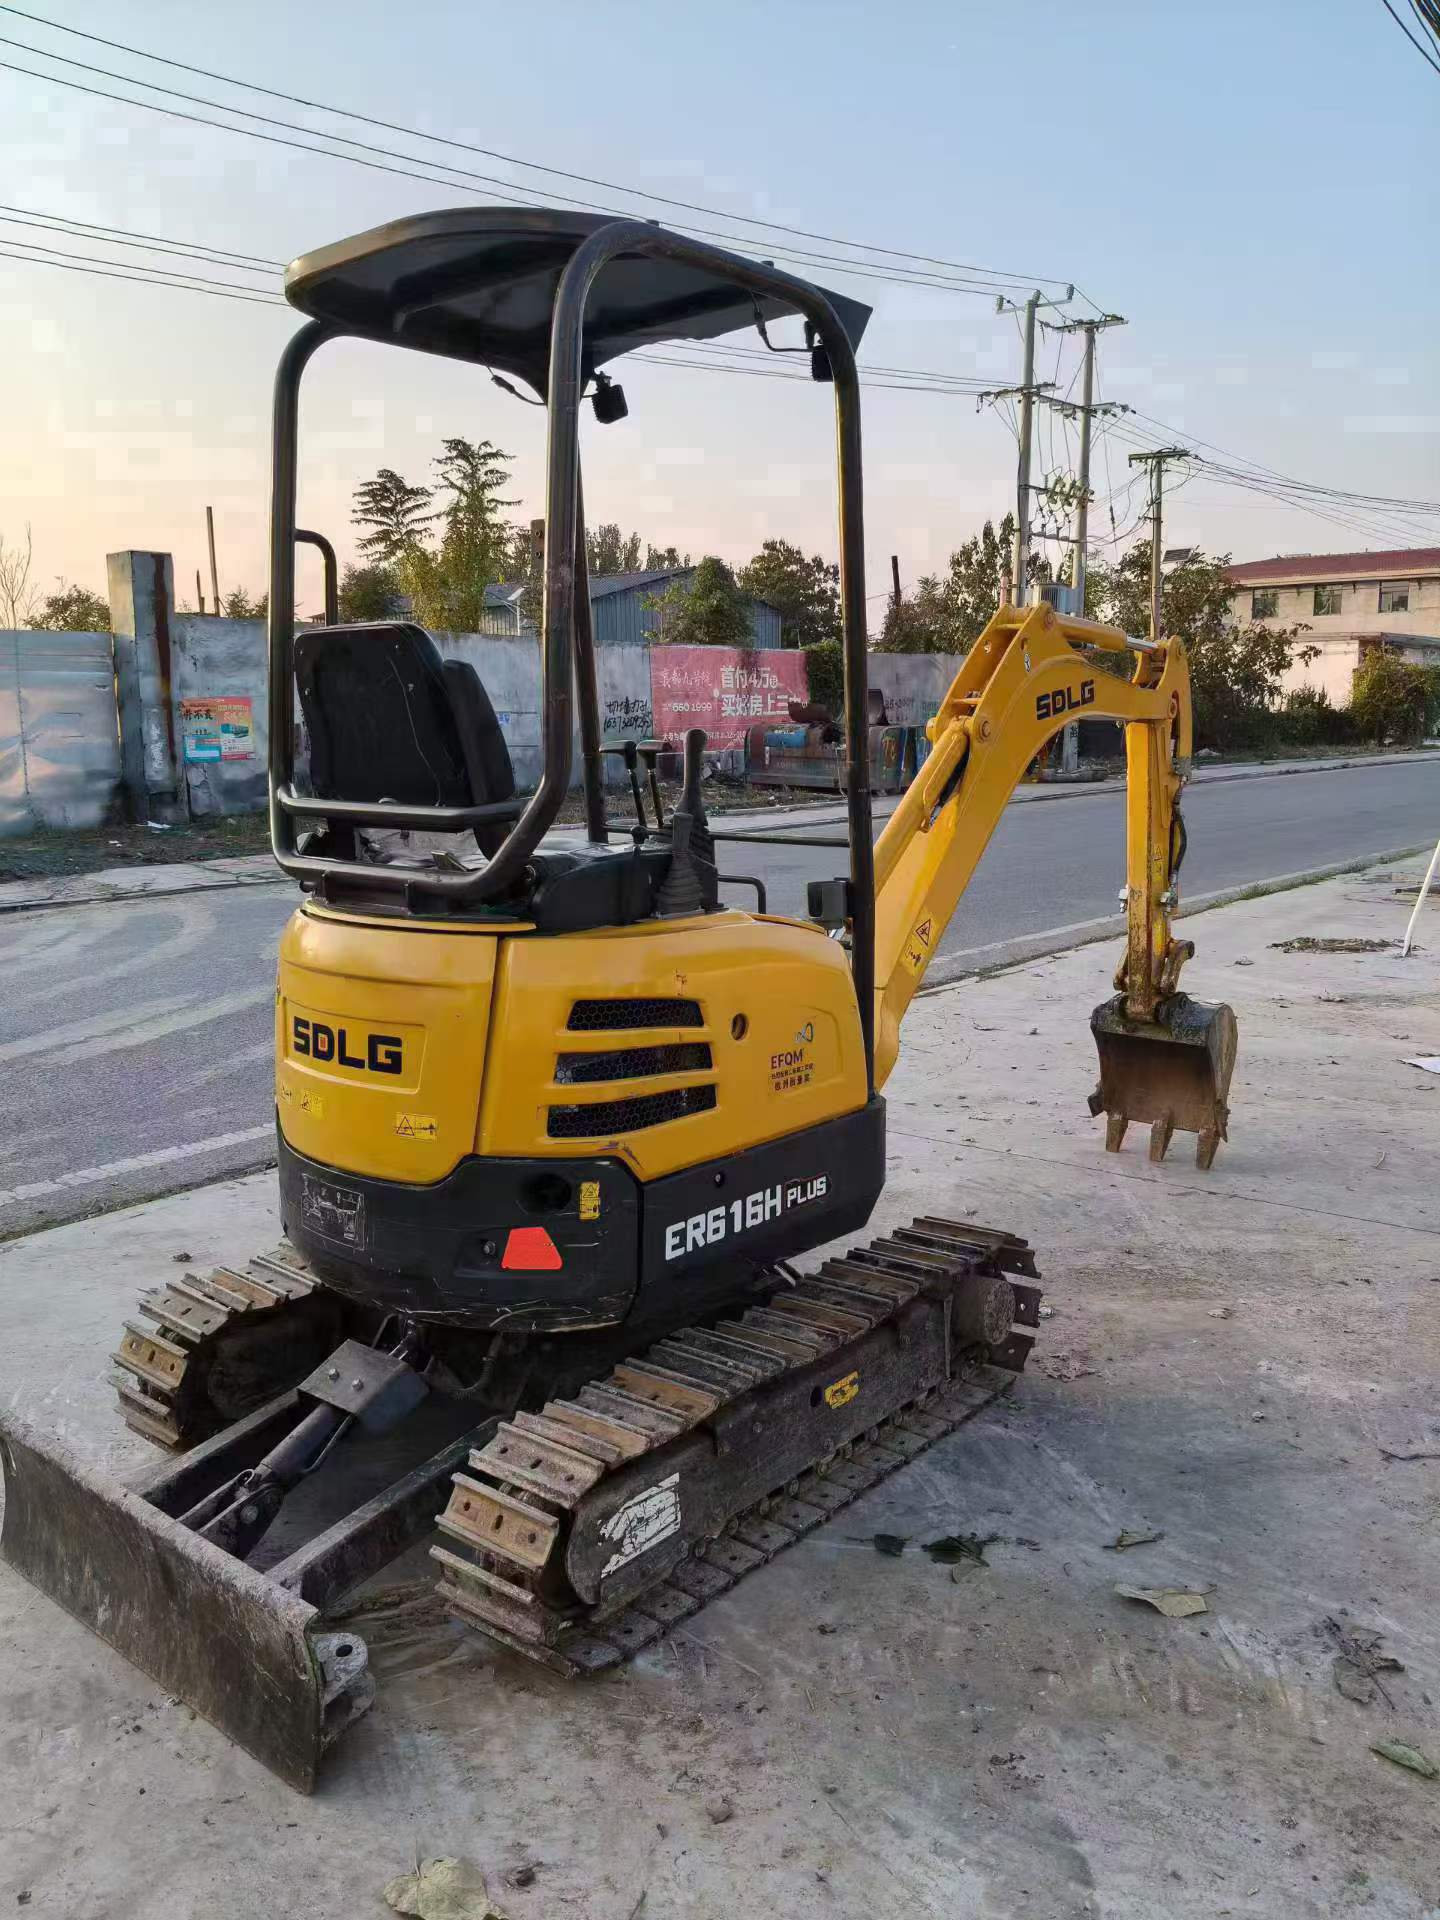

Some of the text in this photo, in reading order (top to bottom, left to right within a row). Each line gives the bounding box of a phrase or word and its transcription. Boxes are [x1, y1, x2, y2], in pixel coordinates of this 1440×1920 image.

[1036, 680, 1095, 720] SDLG
[293, 1015, 403, 1075] SDLG
[771, 1048, 803, 1070] EFQM
[665, 1175, 828, 1261] ER616H PLUS
